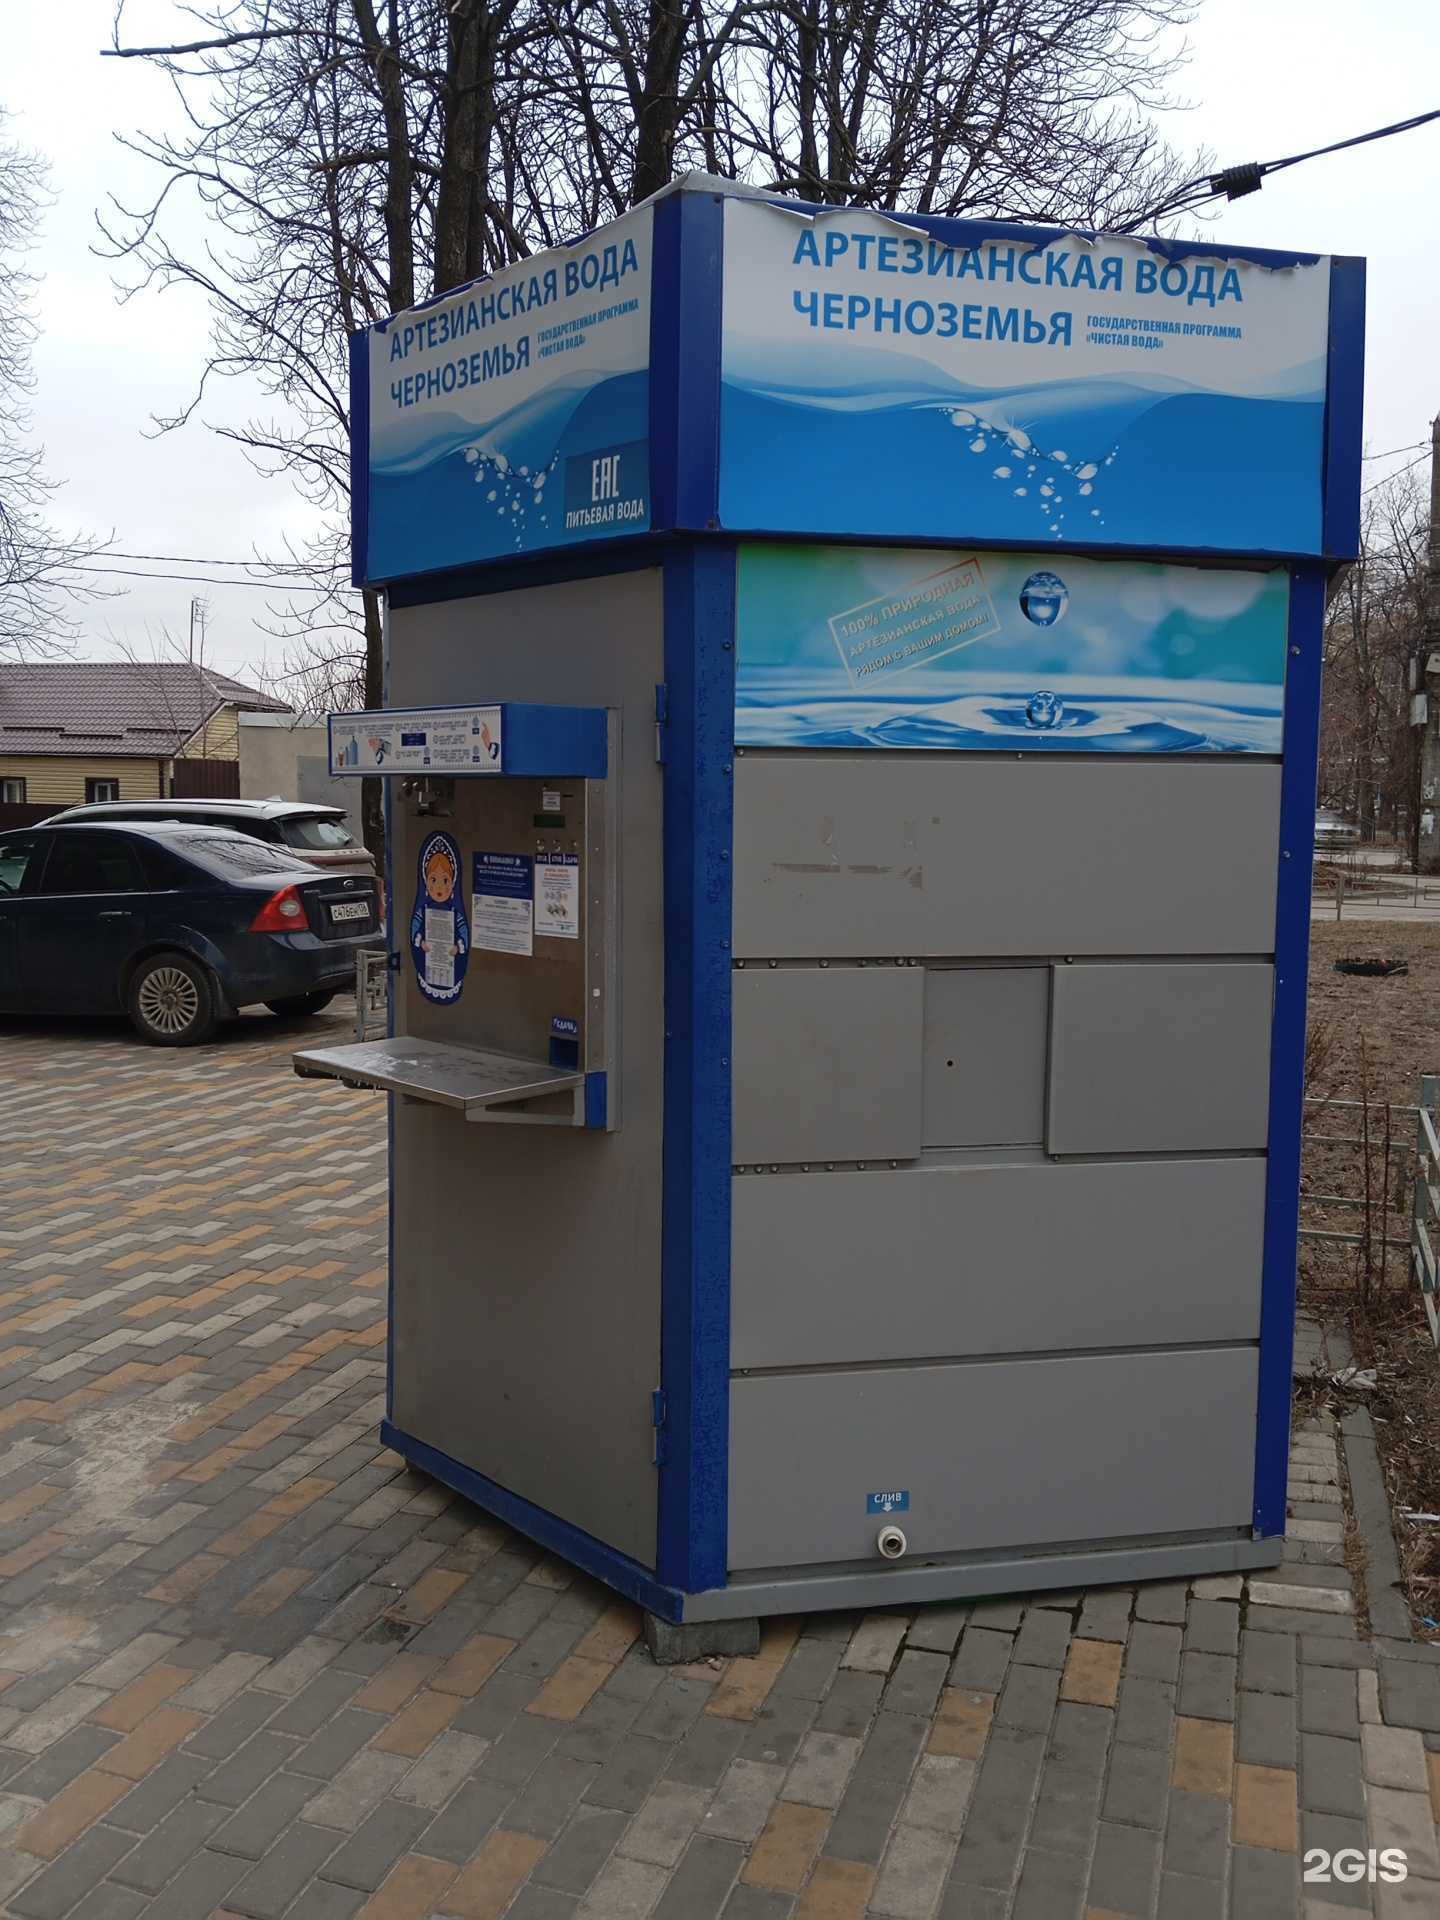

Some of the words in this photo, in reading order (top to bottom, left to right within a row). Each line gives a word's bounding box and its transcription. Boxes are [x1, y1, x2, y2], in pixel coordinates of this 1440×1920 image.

[792, 229, 1123, 291] АРТЕЗИАНСКАЯ
[1136, 259, 1242, 308] ВОДА
[390, 268, 557, 362] АРТЕЗИАНСКАЯ
[565, 238, 638, 292] ВОДА
[537, 312, 597, 344] ГОСУДАРСТВЕННАЯ
[598, 298, 639, 323] ПРОГРАММА
[793, 290, 1072, 346] ЧЕРНОЗЕМЬЯ
[1087, 315, 1181, 335] ГОСУДАРСТВЕННАЯ
[1183, 322, 1242, 339] ПРОГРАММА
[391, 336, 530, 408] ЧЕРНОЗЕМЬЯ
[566, 503, 615, 529] ПИТЬЕВАЯ
[617, 498, 644, 520] ВОДА
[841, 613, 879, 637] 100%
[881, 572, 976, 621] ПРИРОДНАЯ
[851, 608, 945, 657] АРТЕЗИАНСКАЯ
[855, 653, 894, 678] РЯДОМ
[905, 632, 945, 657] ВАШИМ
[874, 1492, 902, 1503] СЛИВ
